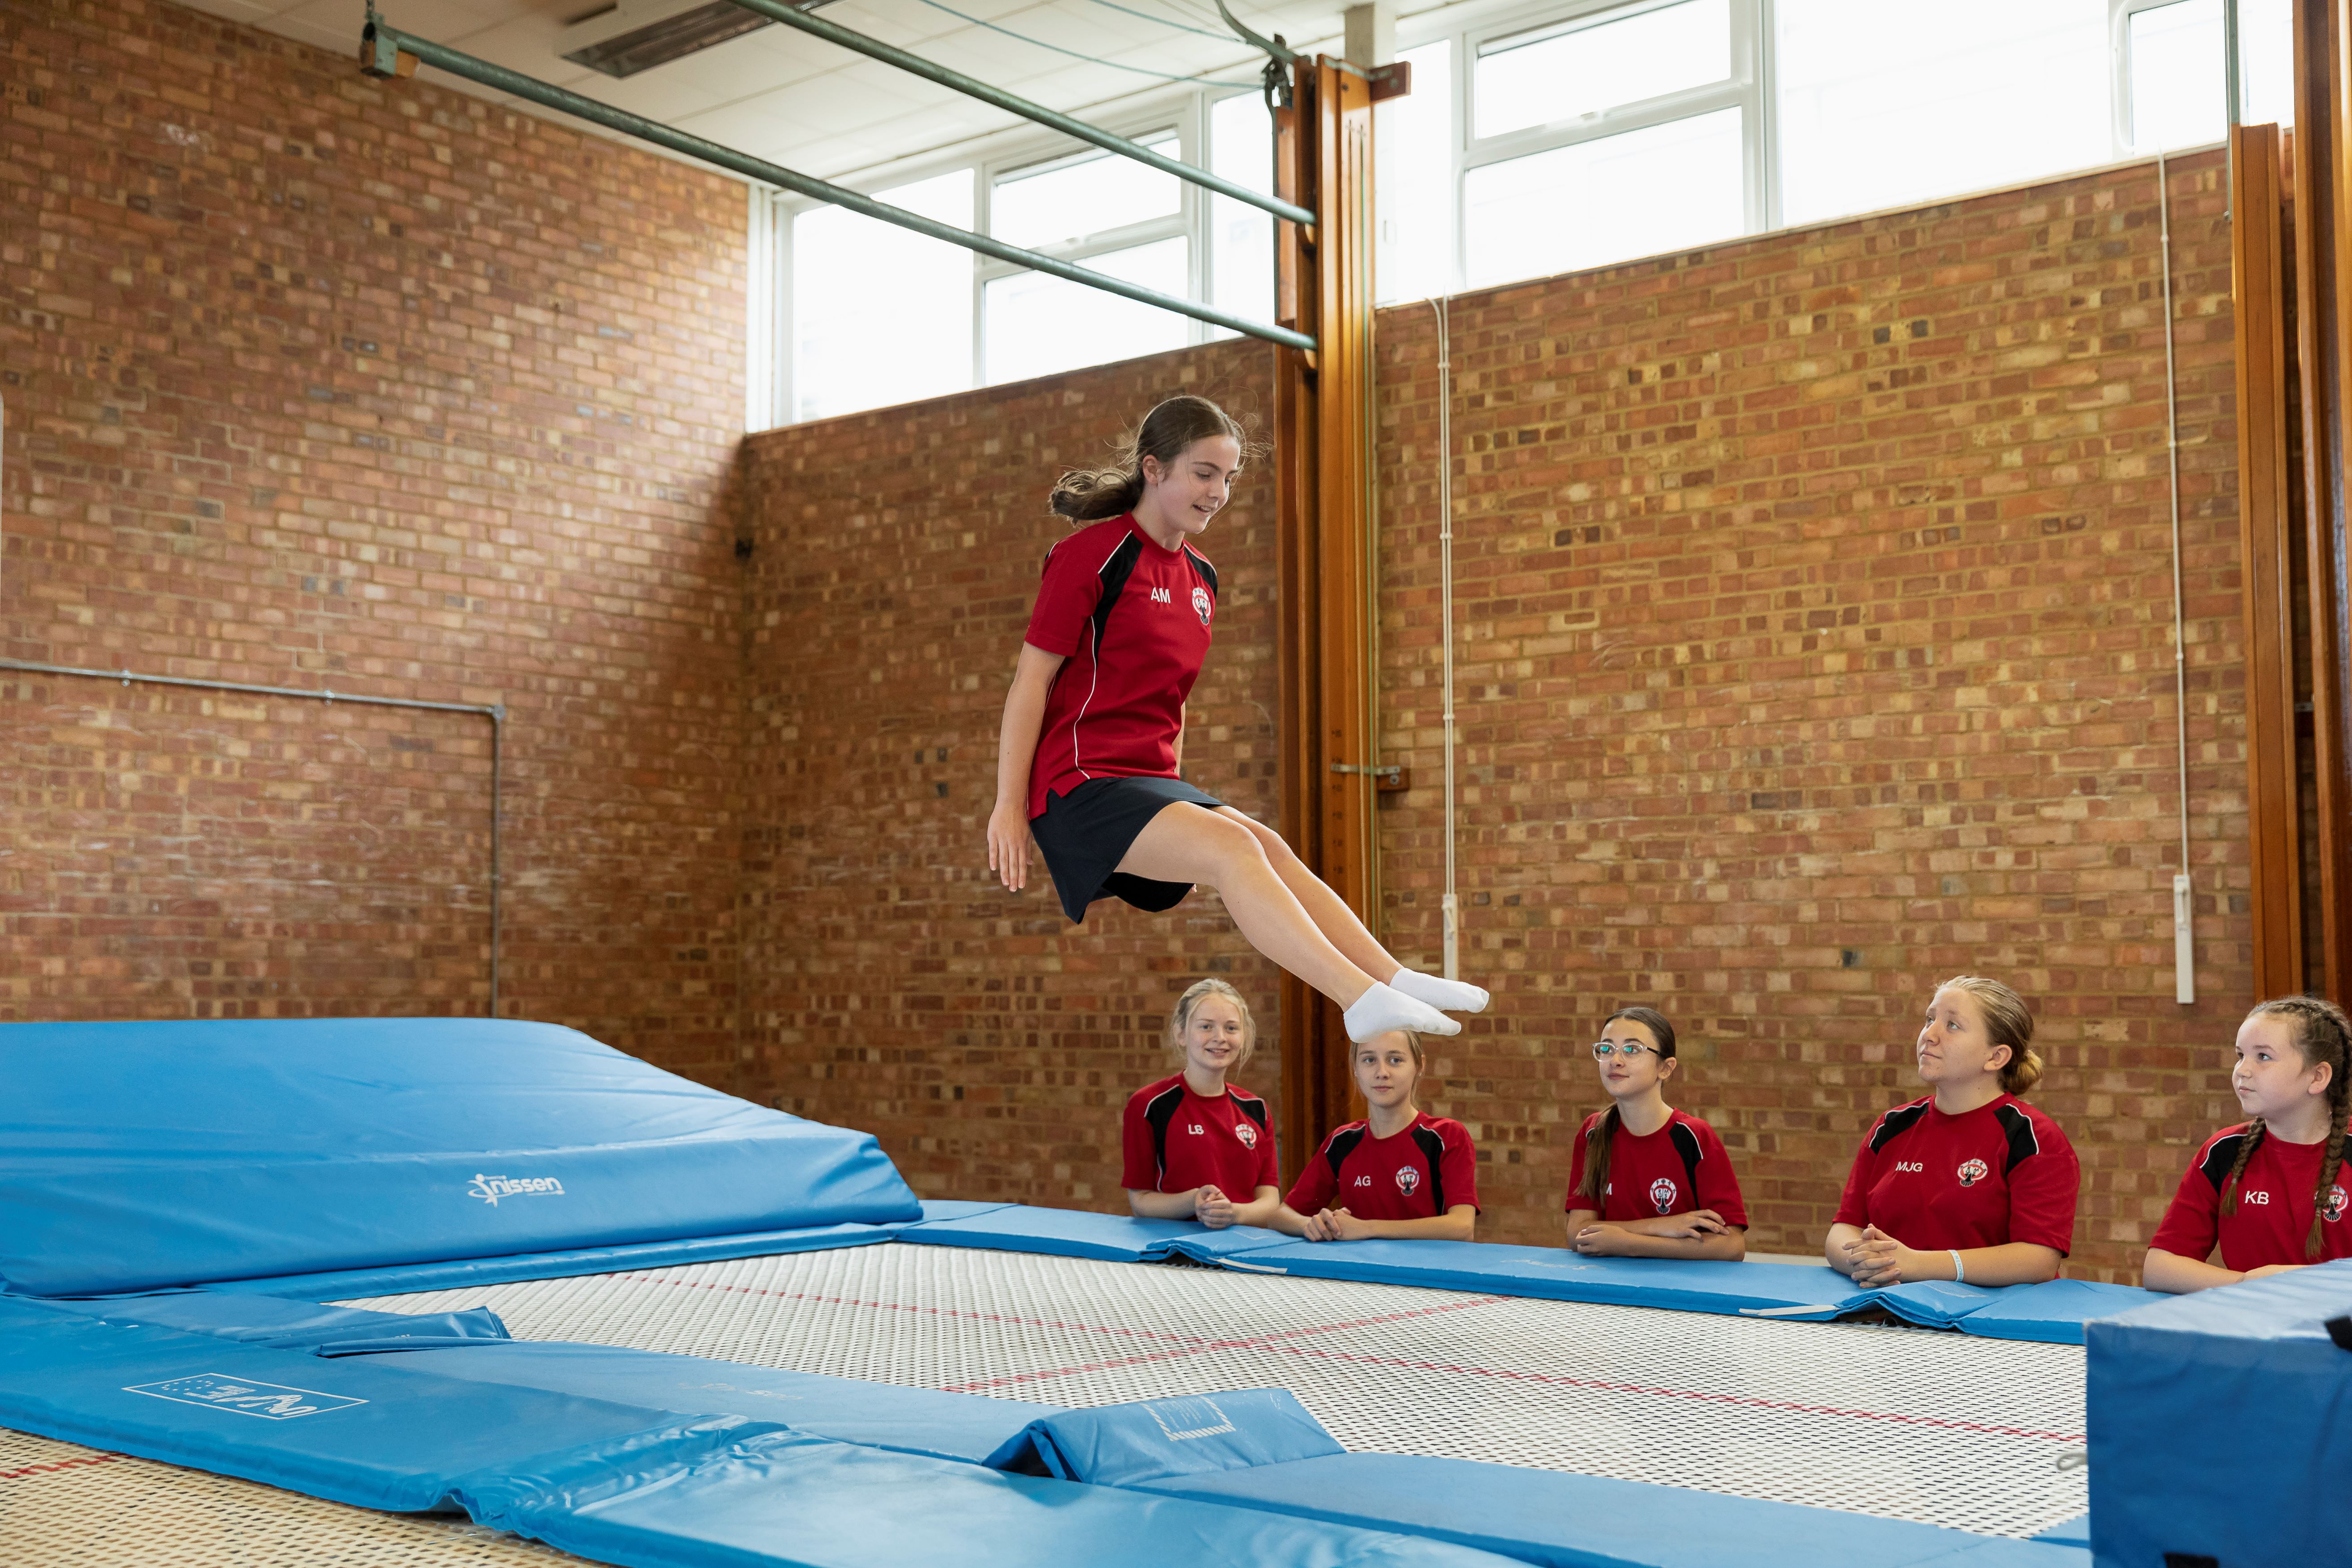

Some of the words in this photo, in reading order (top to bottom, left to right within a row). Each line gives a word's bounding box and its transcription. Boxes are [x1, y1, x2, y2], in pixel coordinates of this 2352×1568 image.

[1151, 587, 1171, 604] AM
[1188, 1124, 1204, 1135] LB
[1895, 1161, 1923, 1172] MJG
[1354, 1175, 1371, 1187] AG
[2245, 1190, 2269, 1205] KB
